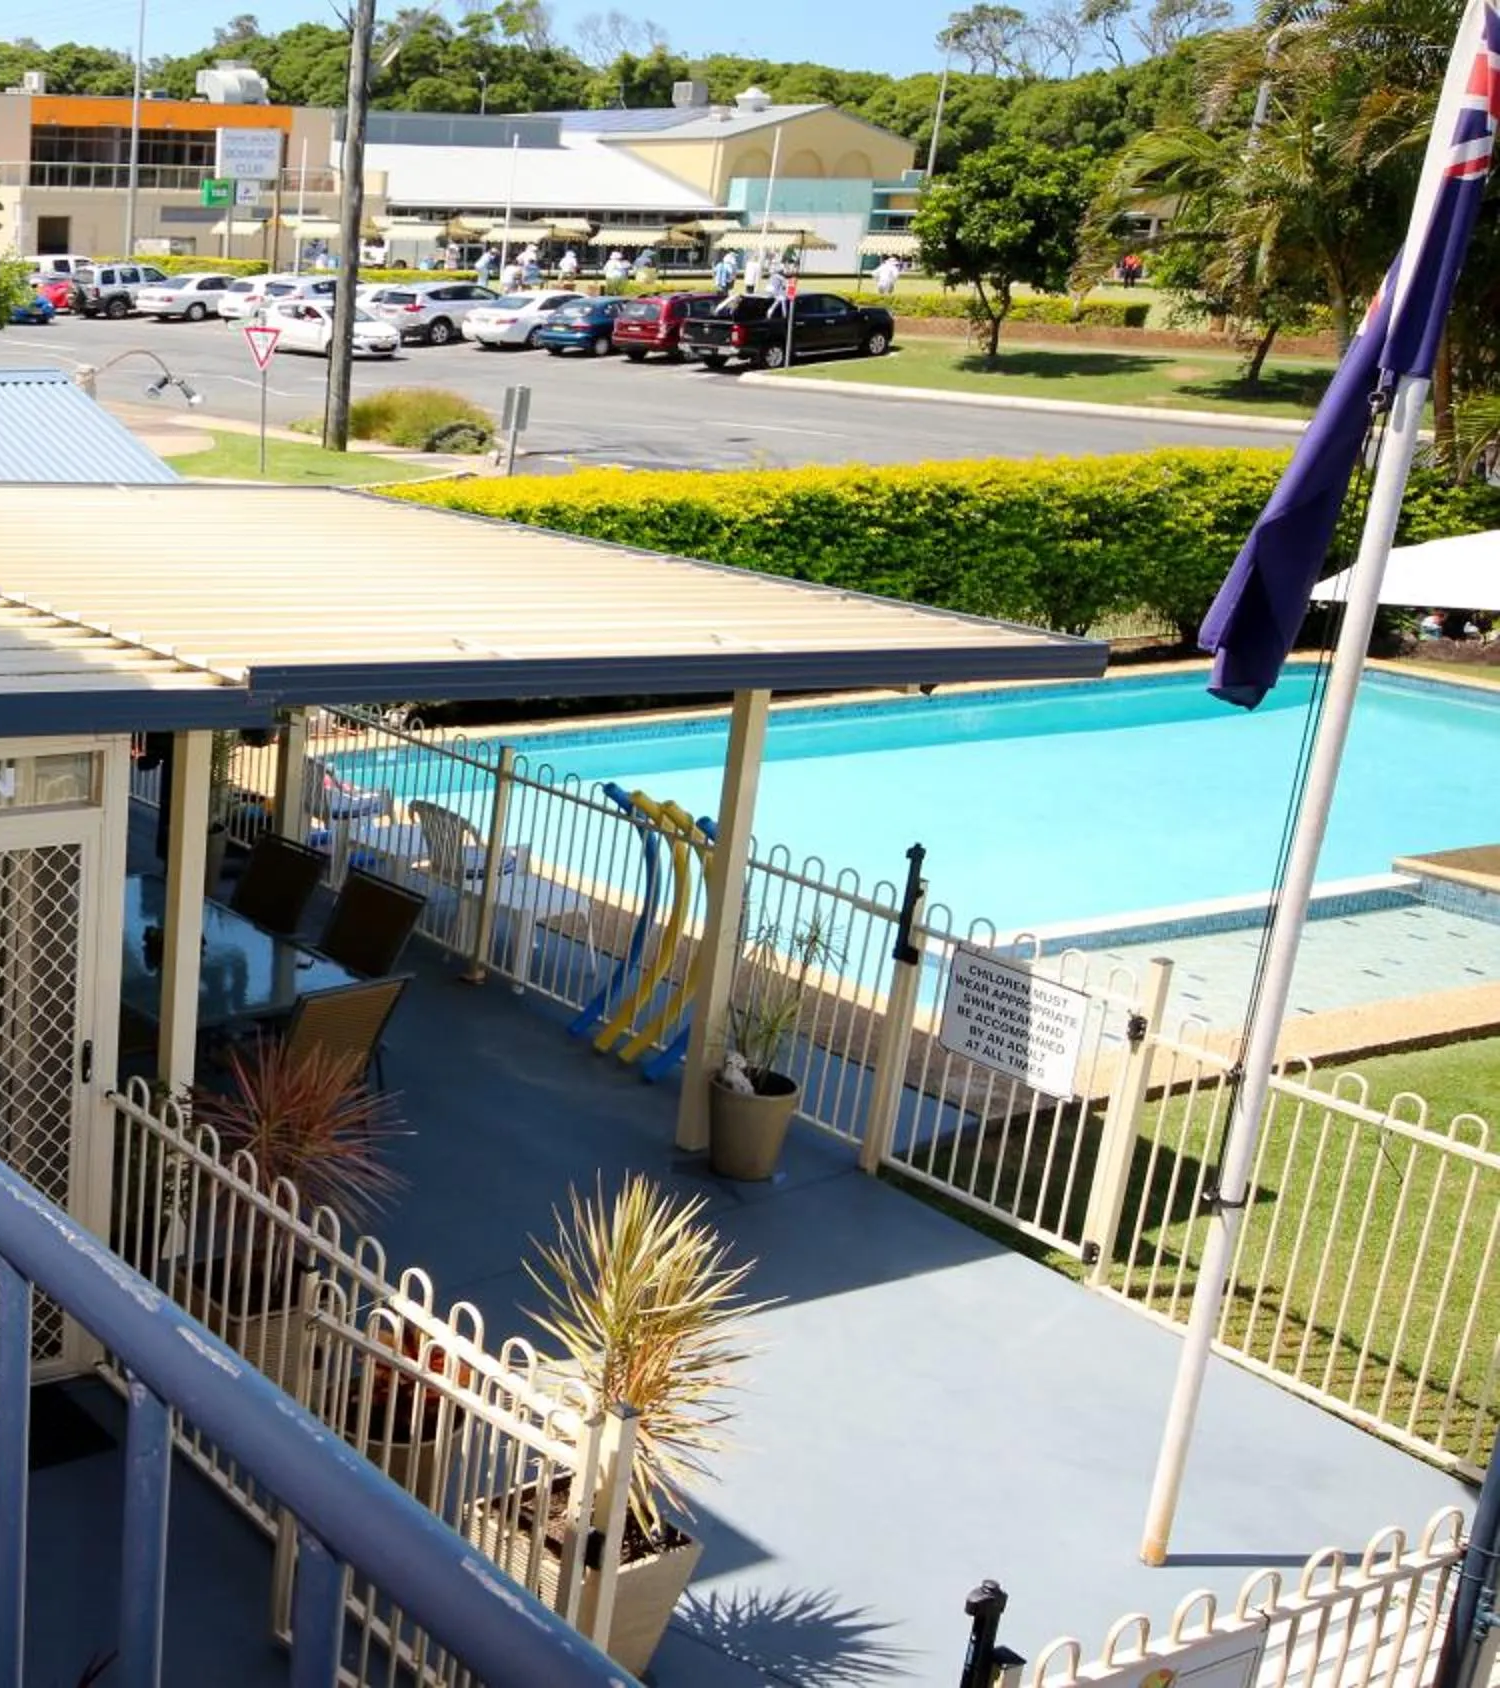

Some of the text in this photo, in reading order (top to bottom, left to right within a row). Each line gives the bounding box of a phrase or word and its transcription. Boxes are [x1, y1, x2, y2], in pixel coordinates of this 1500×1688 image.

[956, 973, 1077, 1029] WEAR APPROPRIATE
[969, 965, 1068, 1008] CHILDREN MUST
[957, 1004, 972, 1019] BE
[963, 992, 1064, 1039] SWIM WEAR AND
[965, 1039, 979, 1050] AT
[982, 1045, 1004, 1062] ALL
[969, 1025, 1045, 1062] BY AN ADULT
